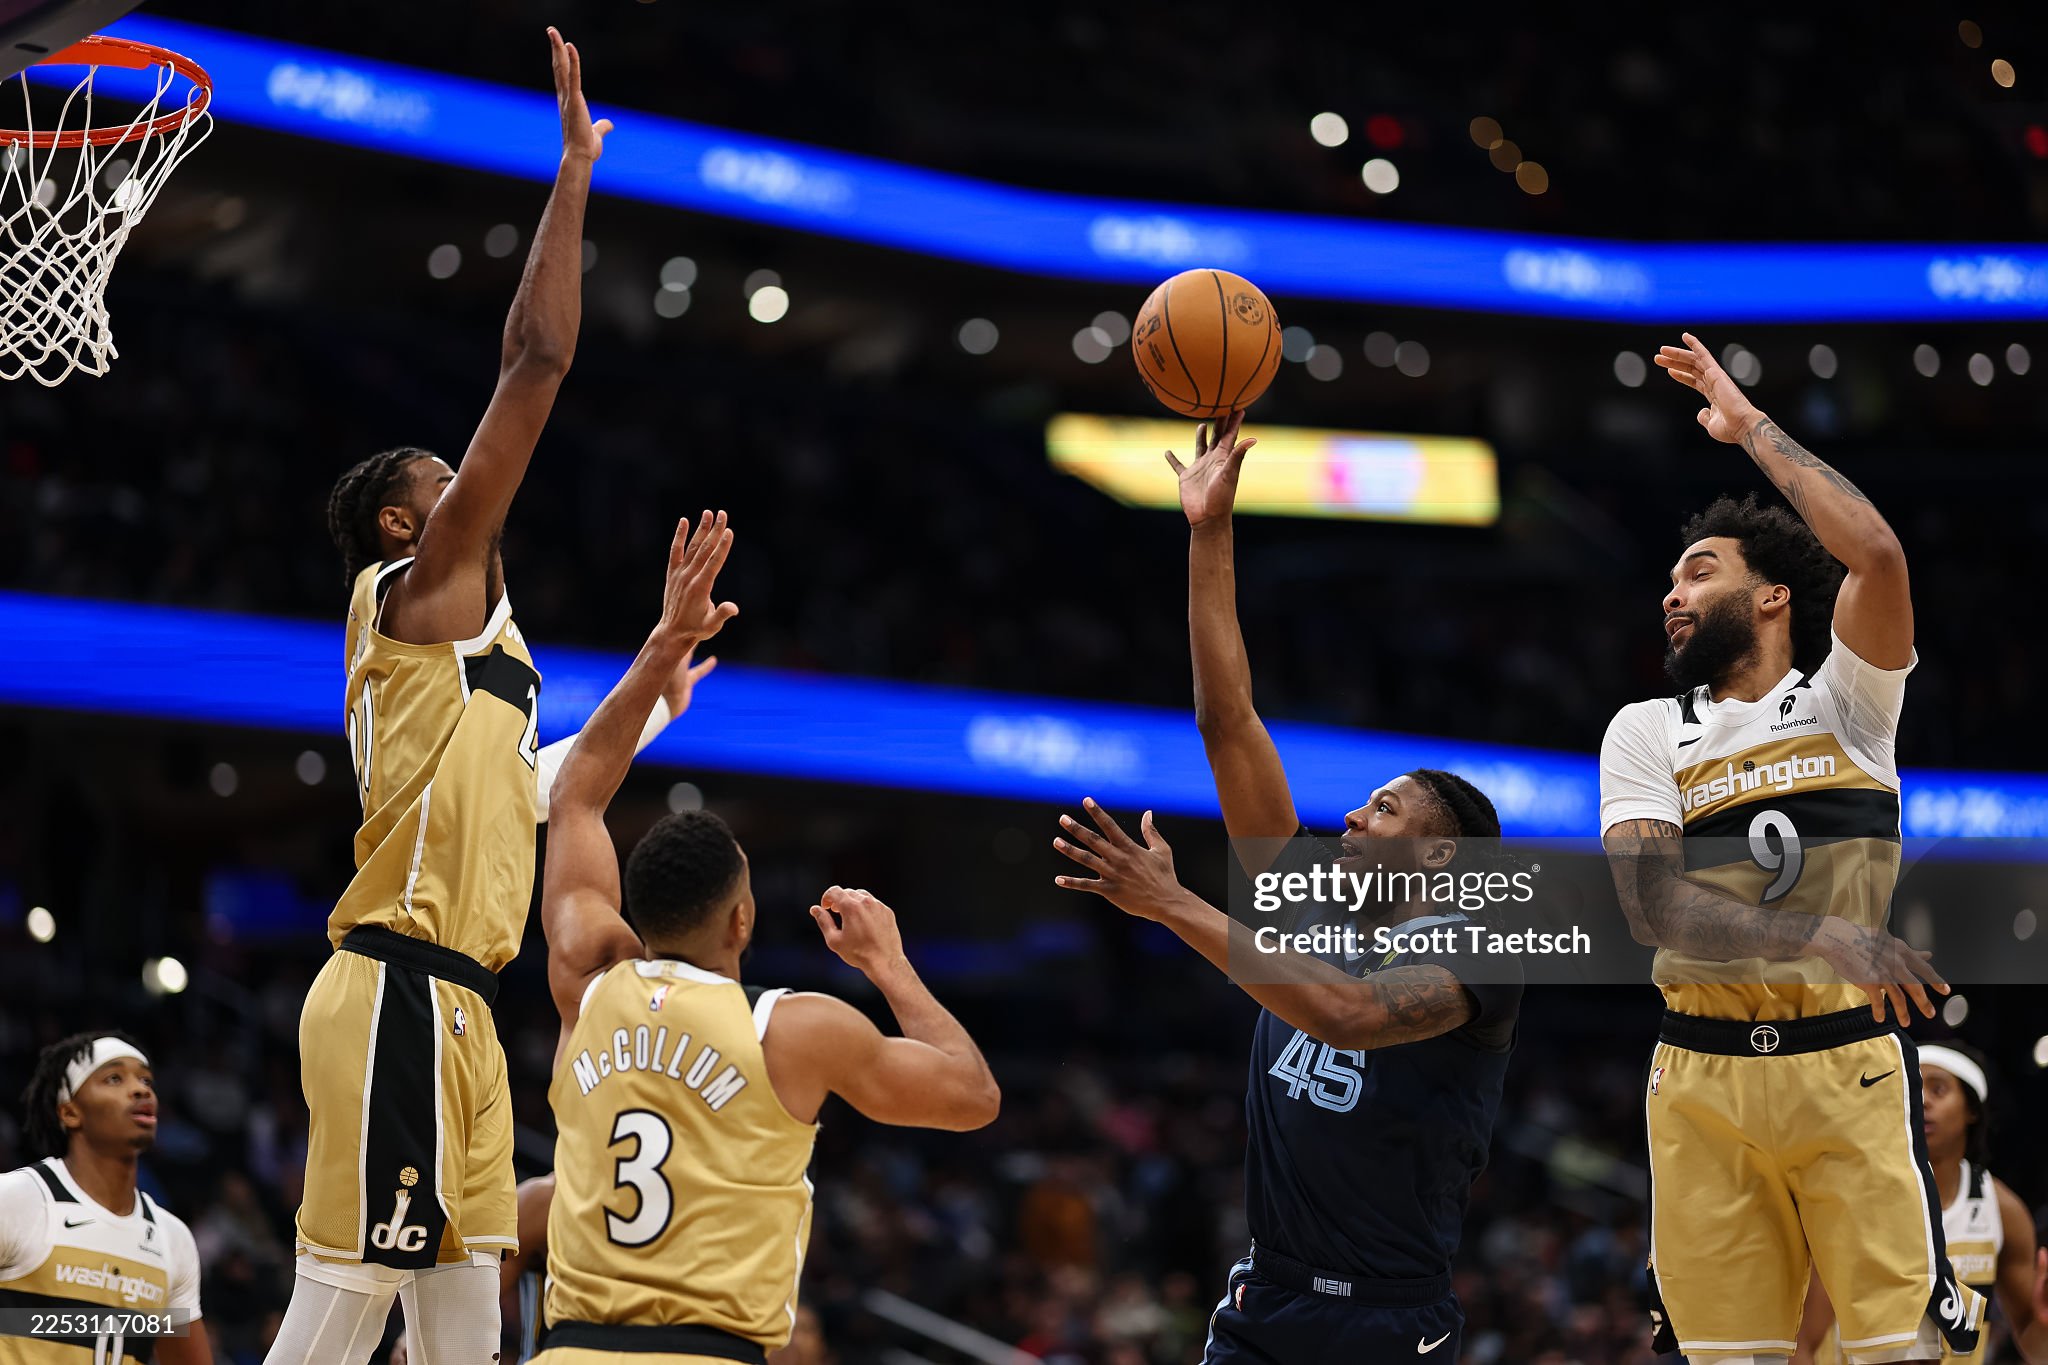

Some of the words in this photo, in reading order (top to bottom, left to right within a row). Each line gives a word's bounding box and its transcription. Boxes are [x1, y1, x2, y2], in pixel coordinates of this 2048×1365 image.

[1769, 715, 1818, 732] Robinhood
[1749, 809, 1805, 905] 9
[572, 1024, 748, 1112] McCOLLUM
[1268, 1029, 1365, 1112] 45
[603, 1108, 674, 1249] 3
[55, 1262, 165, 1305] washington
